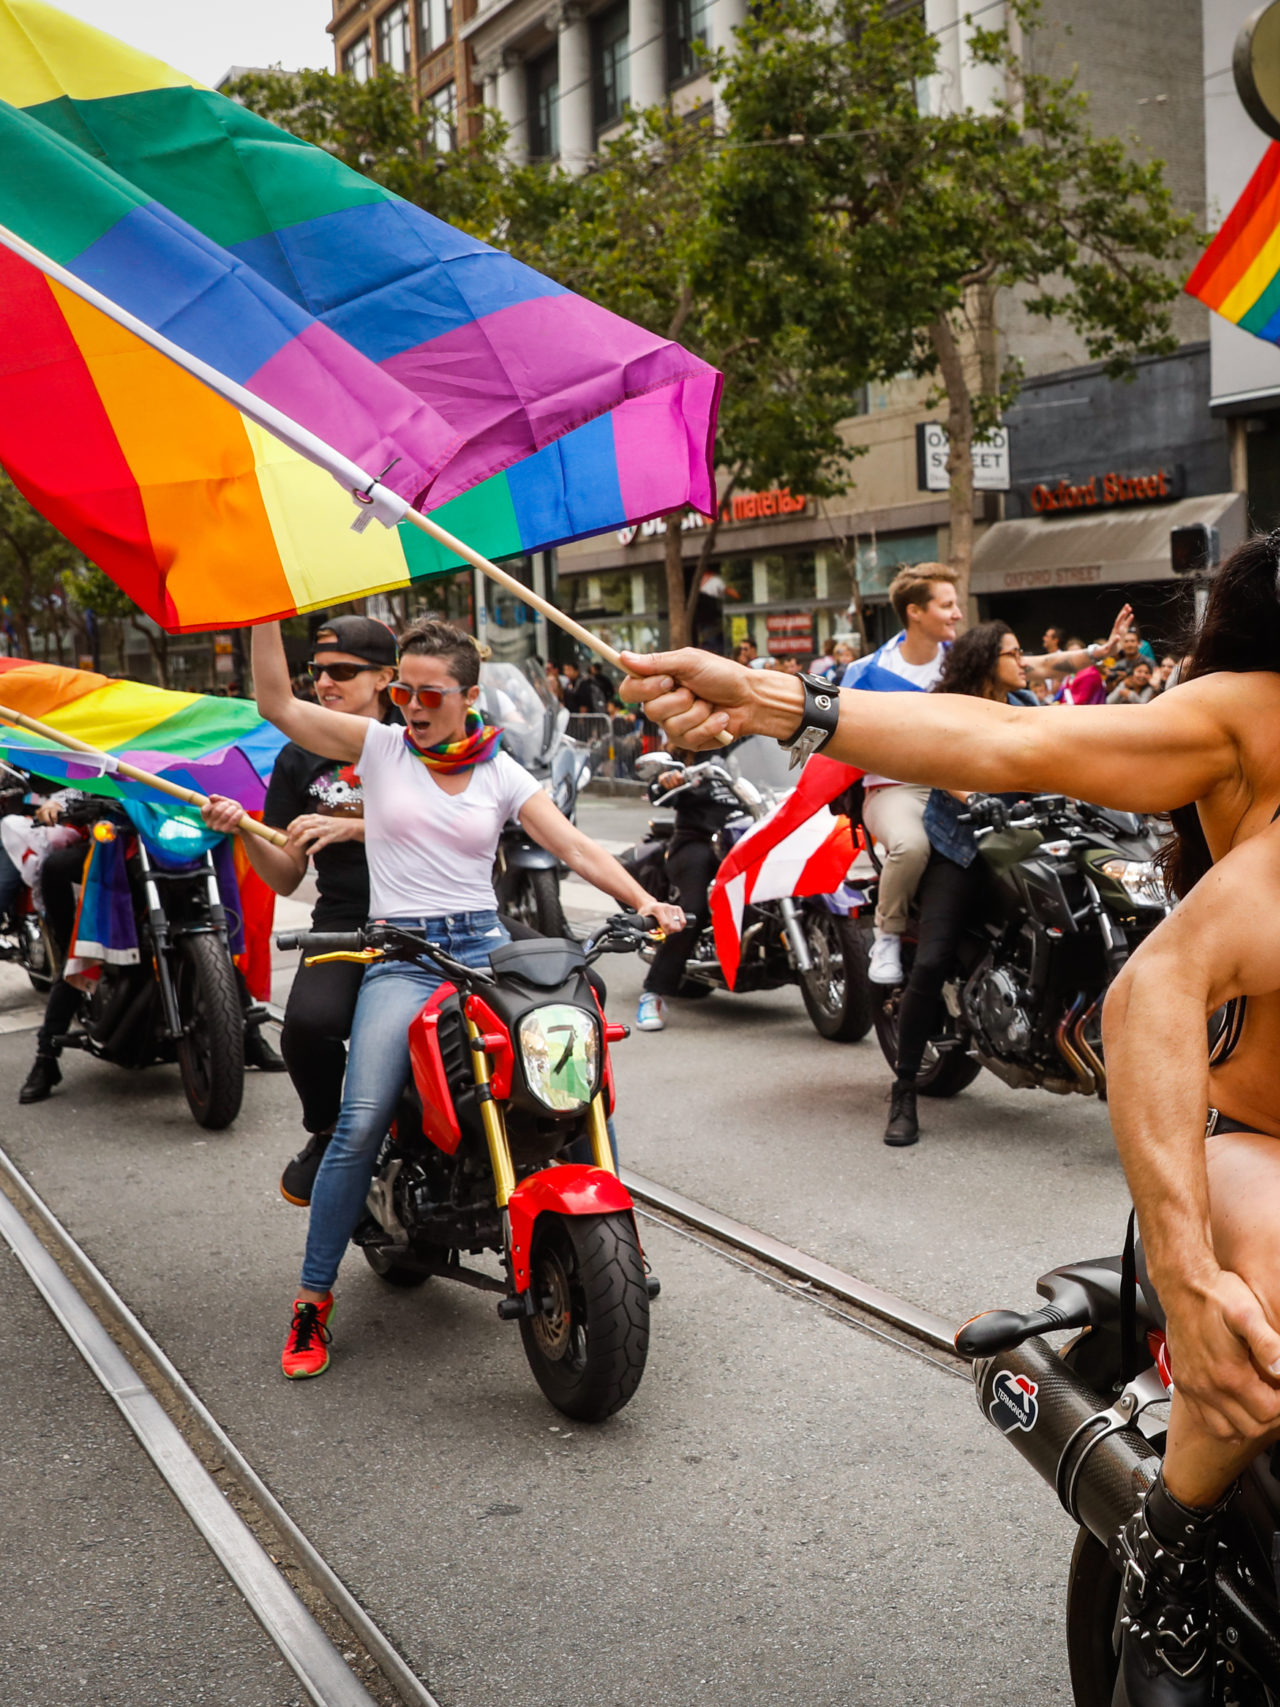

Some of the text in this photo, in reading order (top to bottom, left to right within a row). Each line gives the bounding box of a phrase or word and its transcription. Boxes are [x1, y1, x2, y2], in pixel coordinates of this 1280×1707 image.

[1031, 467, 1168, 513] Oxford Street
[547, 1024, 578, 1075] 7
[997, 1387, 1028, 1424] TERMIGNONI
